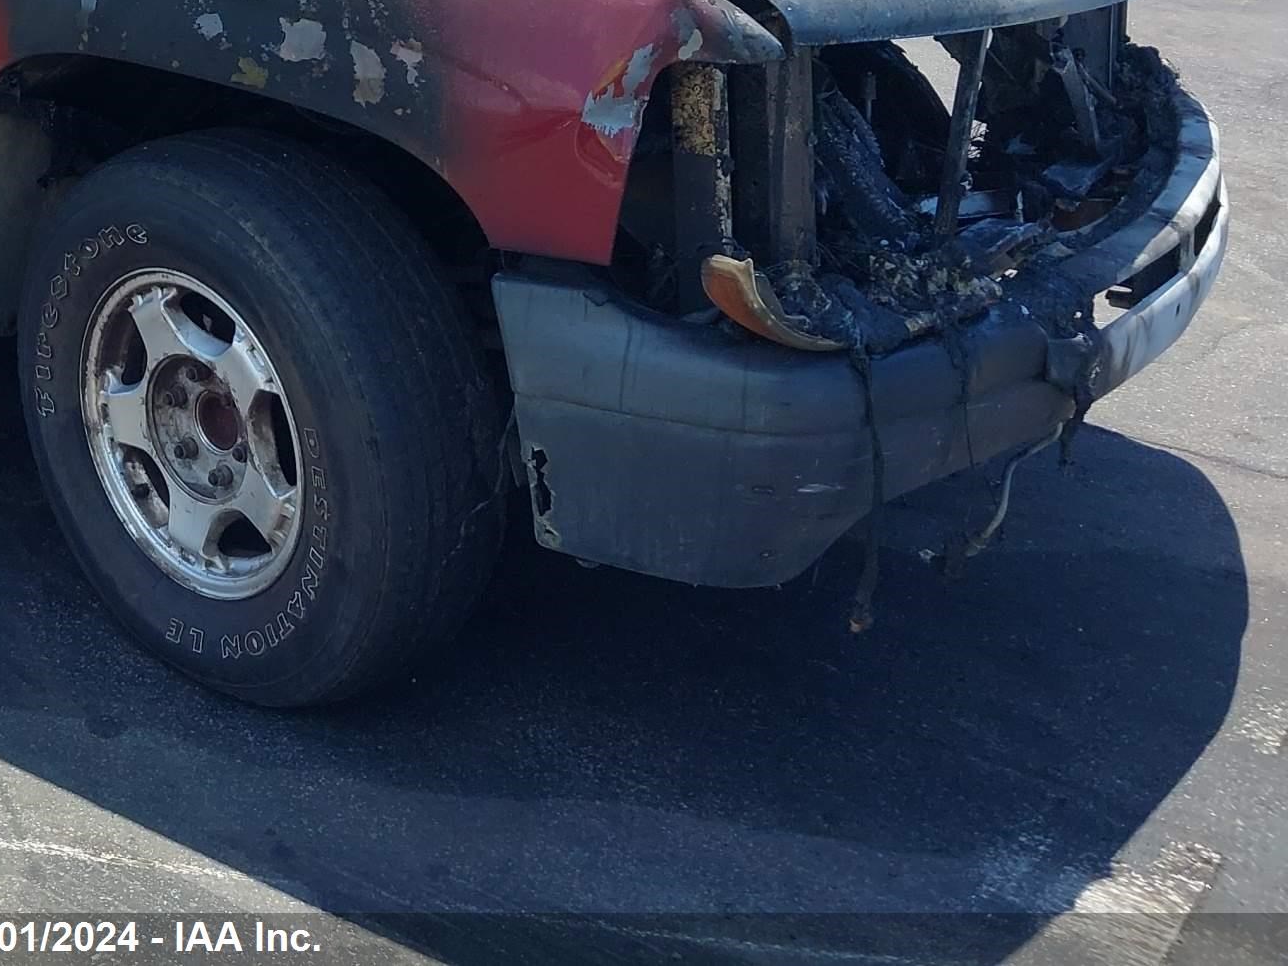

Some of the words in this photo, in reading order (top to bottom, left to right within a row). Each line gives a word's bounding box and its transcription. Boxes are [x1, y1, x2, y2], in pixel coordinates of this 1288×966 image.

[34, 223, 149, 419] Firestone
[165, 617, 205, 654] LE
[219, 427, 331, 660] DESTINATION
